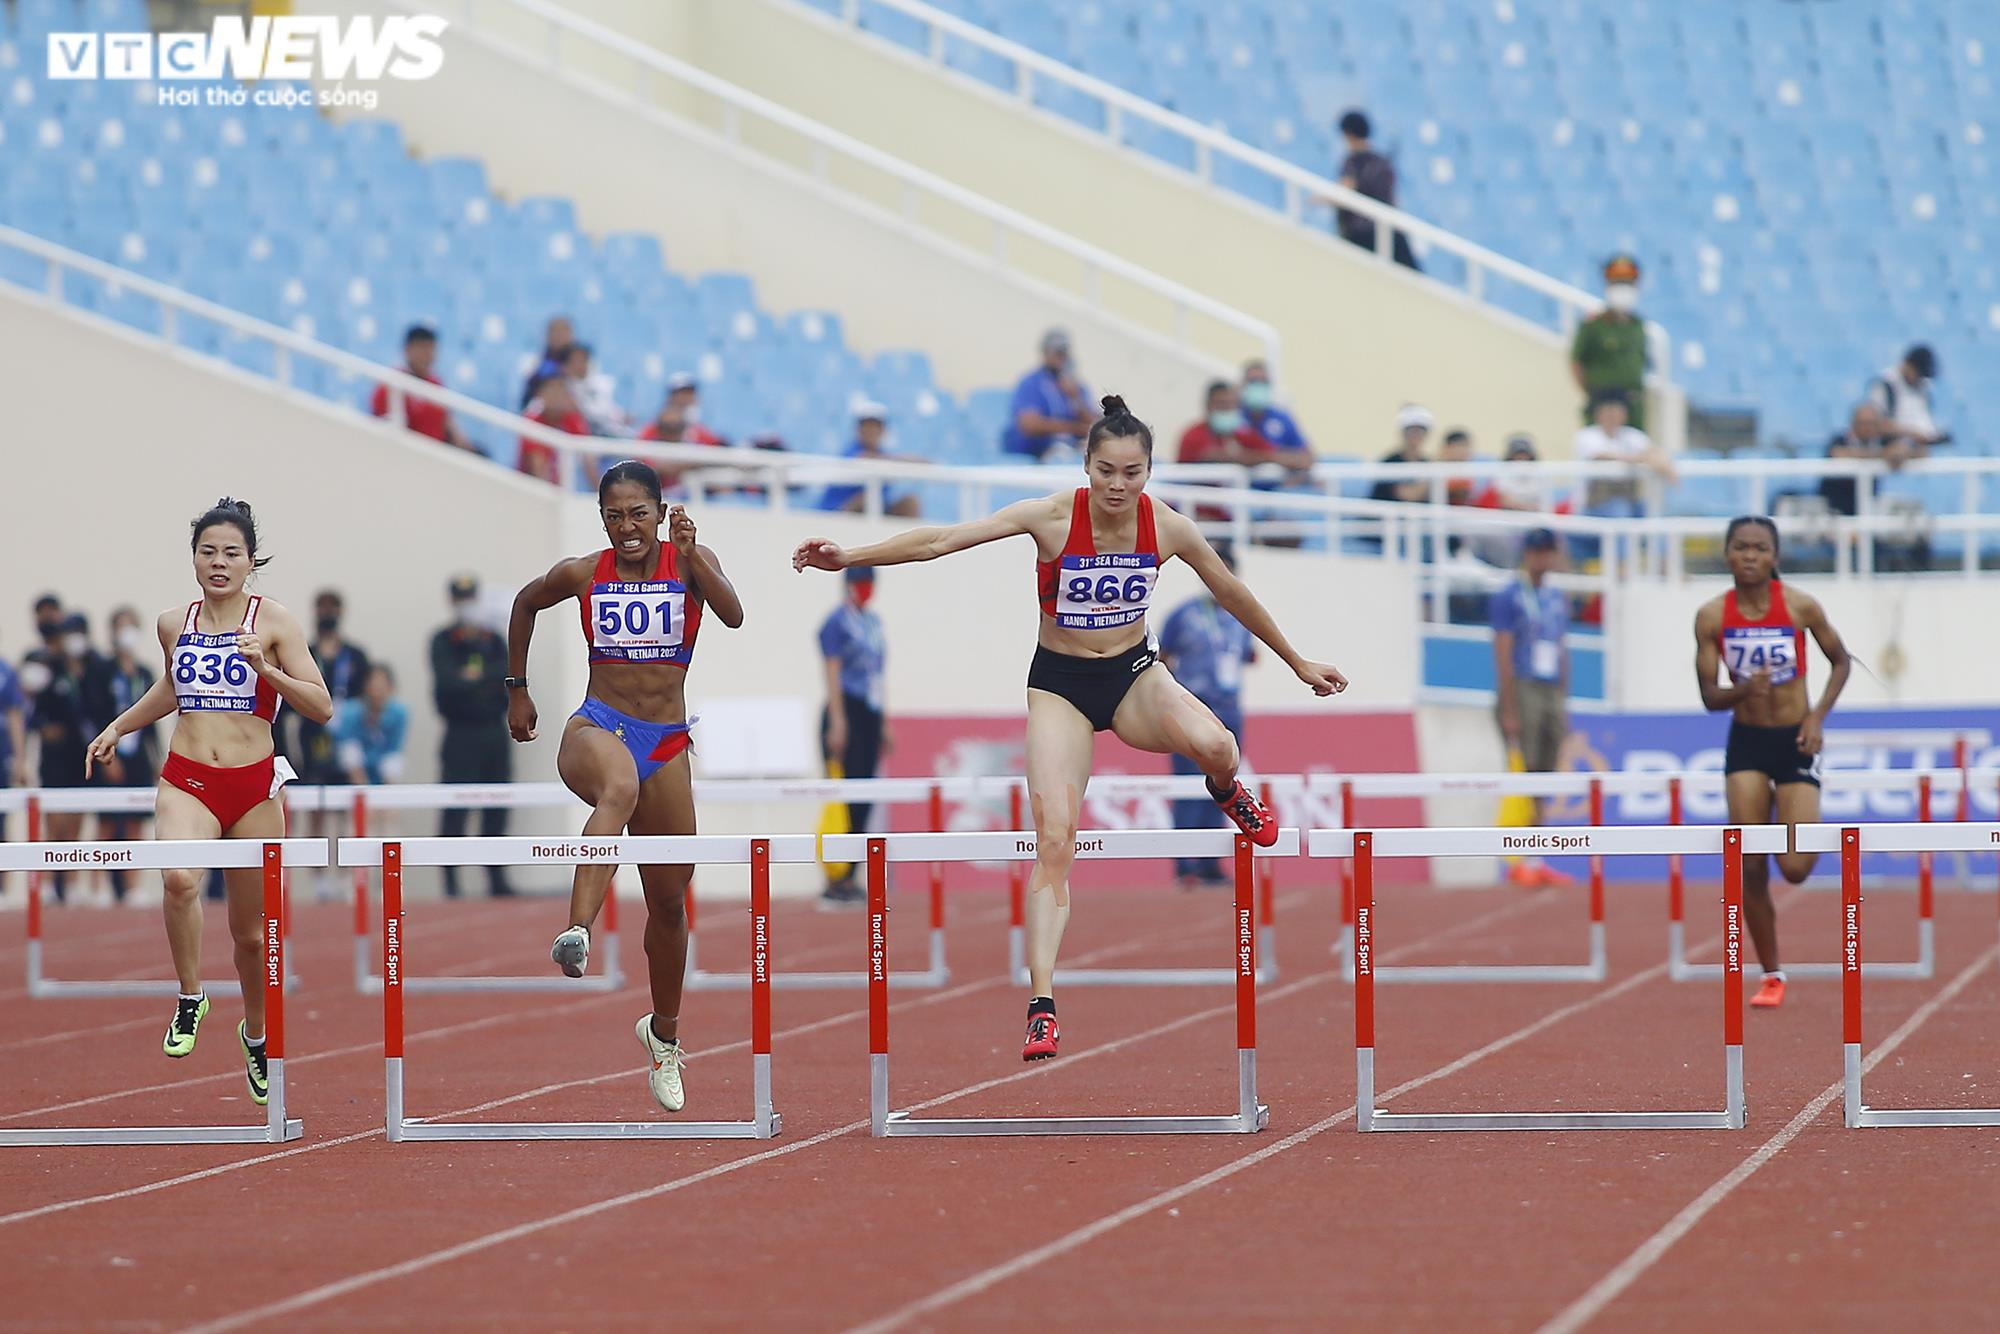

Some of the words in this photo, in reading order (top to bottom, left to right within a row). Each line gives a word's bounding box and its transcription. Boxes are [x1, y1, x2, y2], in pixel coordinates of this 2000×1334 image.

[1094, 556, 1110, 566] SEA
[1112, 557, 1140, 567] Games
[624, 583, 640, 592] SEA
[642, 583, 668, 592] Games
[1066, 575, 1147, 603] 866
[600, 601, 671, 635] 501
[1063, 616, 1088, 626] HANOI
[1094, 612, 1126, 627] VIETNAM
[203, 636, 218, 647] SEA
[218, 635, 237, 646] Game
[627, 648, 659, 660] VIETNAM
[1730, 645, 1787, 668] 745
[176, 652, 248, 686] 836
[180, 697, 196, 708] ANOI
[200, 697, 232, 709] VIETNAM
[232, 700, 250, 709] 2022
[580, 844, 620, 859] Sport
[1074, 839, 1104, 854] port
[1551, 835, 1591, 850] Sport
[92, 850, 132, 865] Sport
[754, 952, 767, 983] Sport
[871, 950, 884, 981] Sport
[1239, 946, 1251, 976] Sport
[1358, 944, 1370, 975] Sport
[1727, 941, 1739, 972] Sport
[1845, 940, 1858, 971] Sport
[267, 955, 279, 986] Sport
[386, 955, 399, 986] Sport
